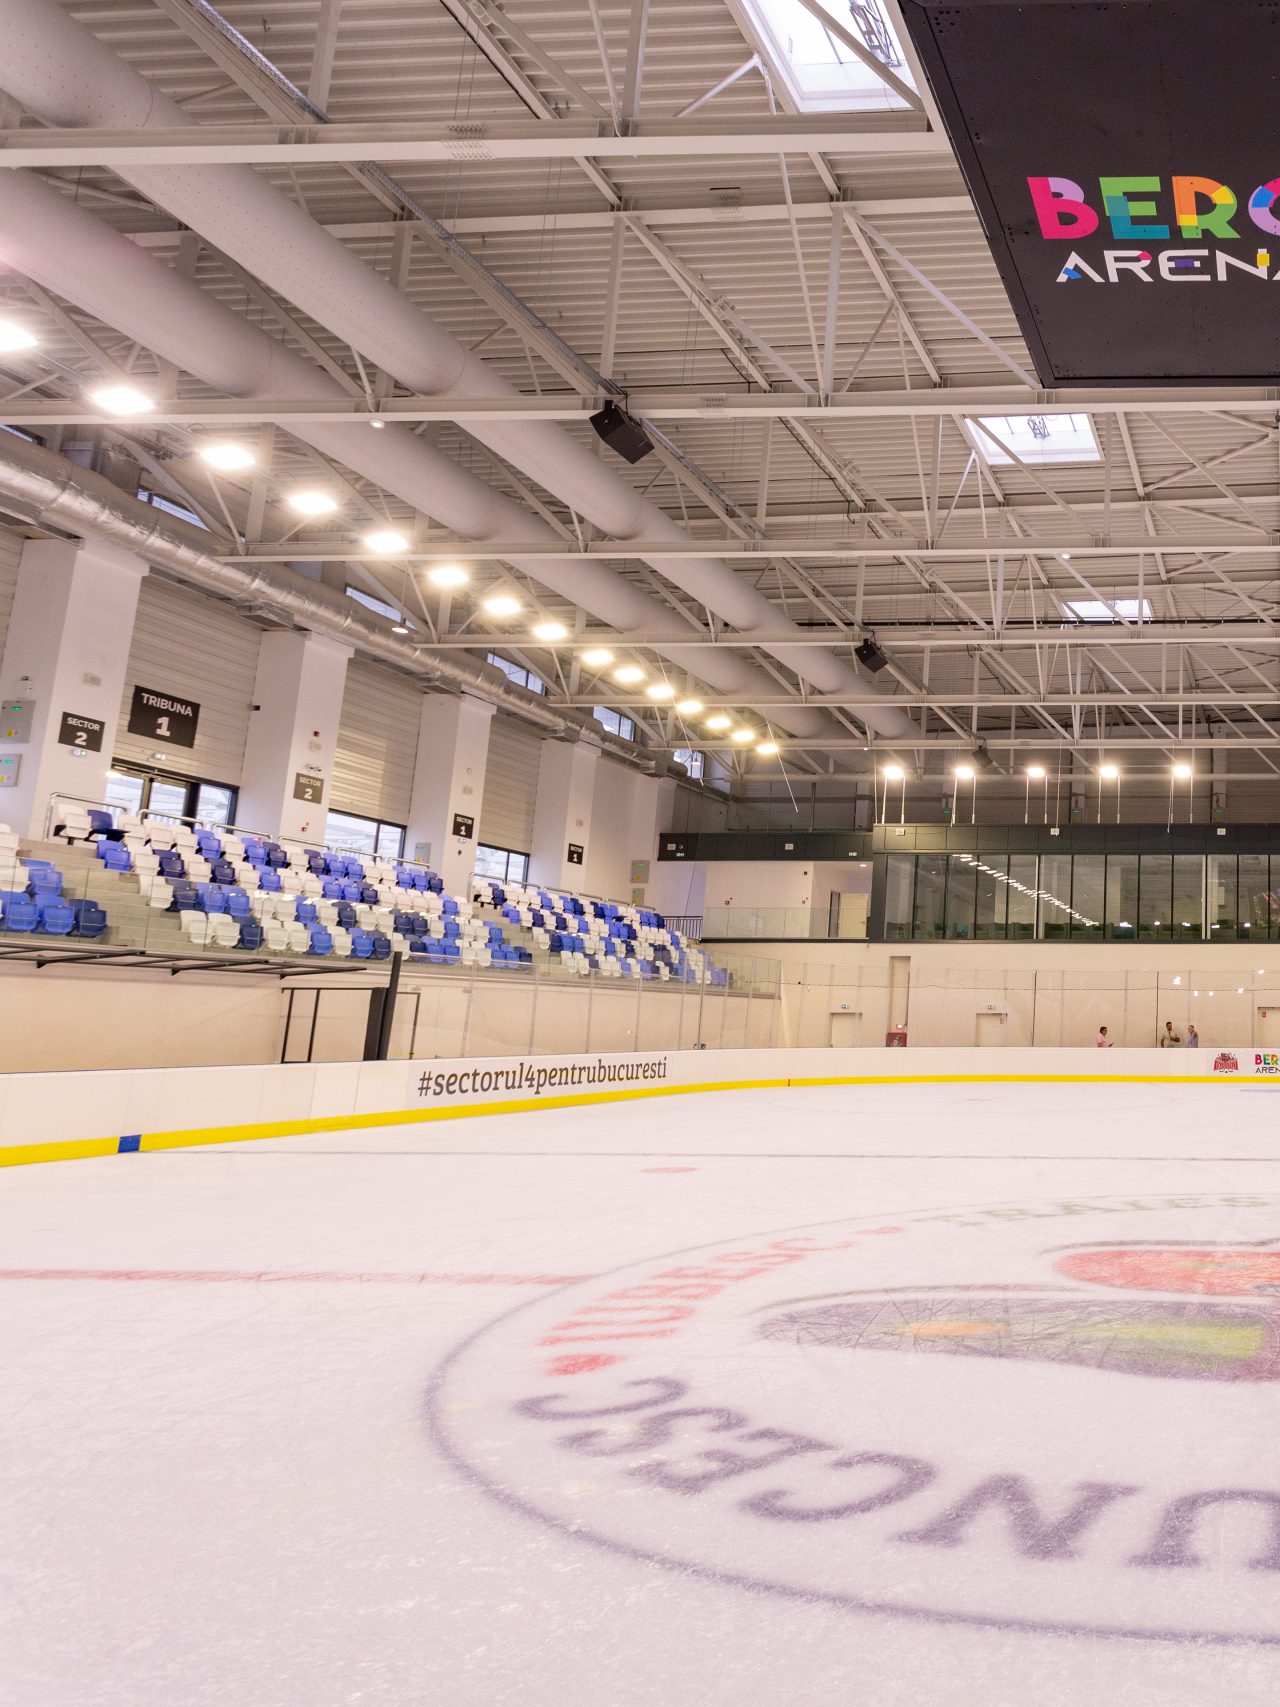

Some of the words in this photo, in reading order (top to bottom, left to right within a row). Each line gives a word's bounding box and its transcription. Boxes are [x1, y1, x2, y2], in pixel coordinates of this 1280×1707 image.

[140, 692, 193, 717] TRIBUNA
[66, 716, 101, 732] SECTOR
[155, 716, 171, 737] 1
[74, 731, 87, 746] 2
[299, 776, 321, 788] SECTOR
[303, 788, 313, 800] 2
[460, 825, 466, 836] 1
[572, 853, 578, 863] 1
[418, 1056, 668, 1097] #sectorul4pentrubucuresti
